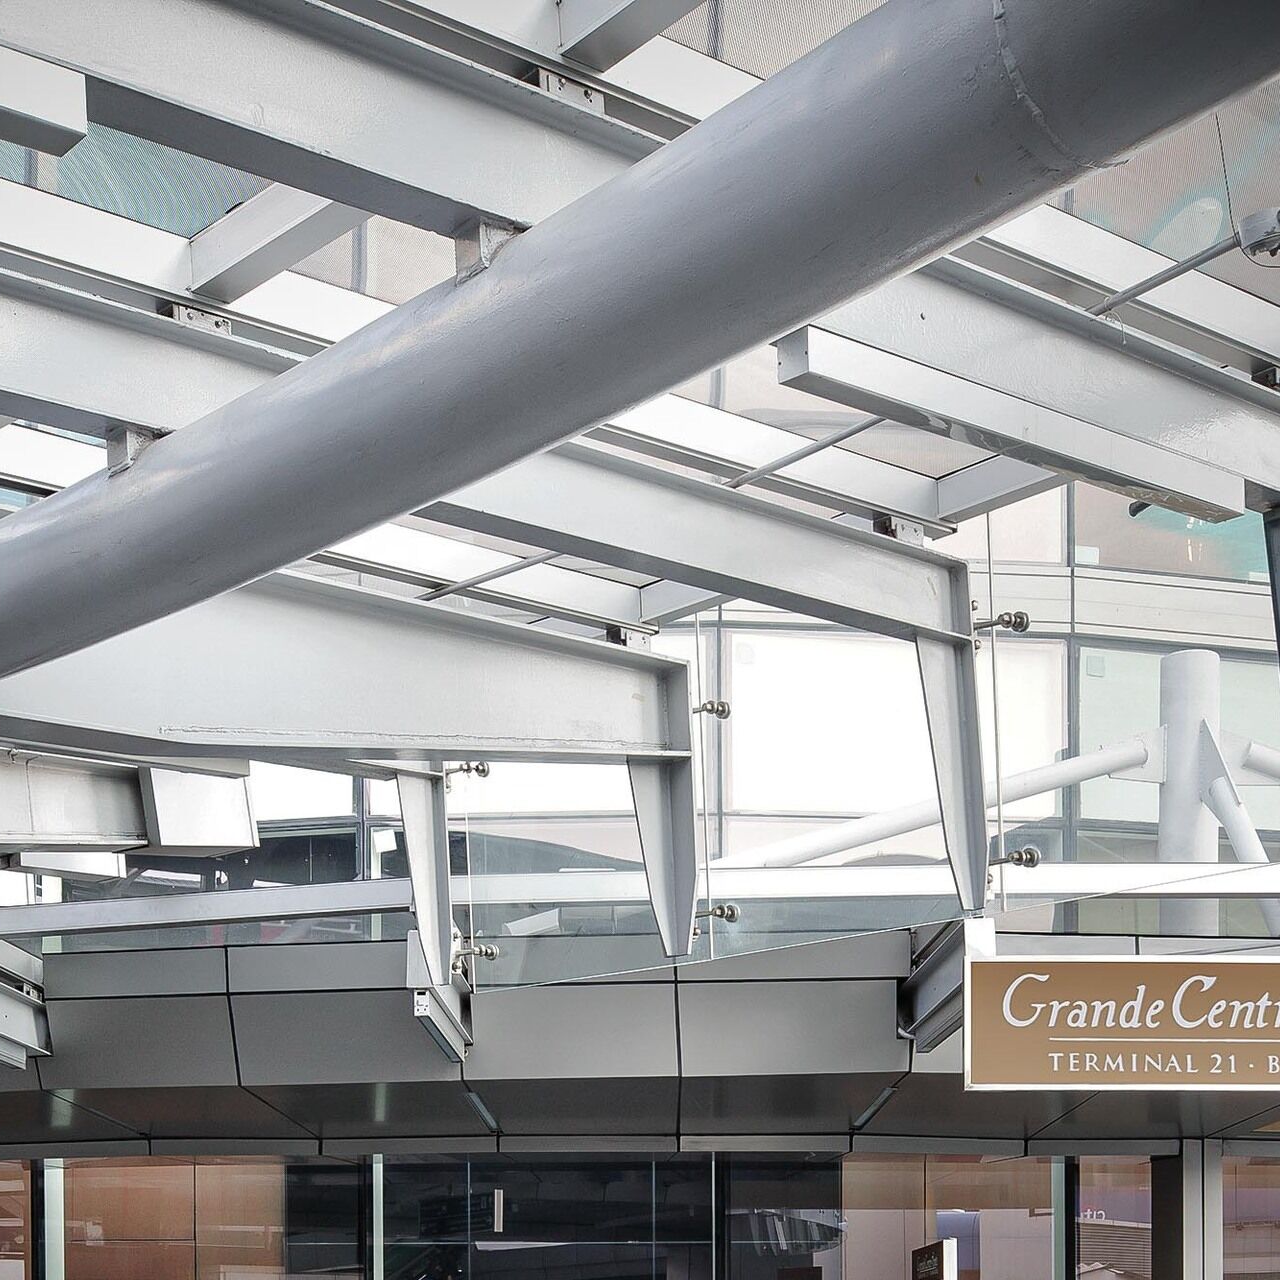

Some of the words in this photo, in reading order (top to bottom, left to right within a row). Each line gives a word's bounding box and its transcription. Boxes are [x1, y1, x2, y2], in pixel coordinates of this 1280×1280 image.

[1002, 973, 1164, 1029] Grande
[1048, 1053, 1199, 1074] TERMINAL
[1210, 1053, 1237, 1074] 21
